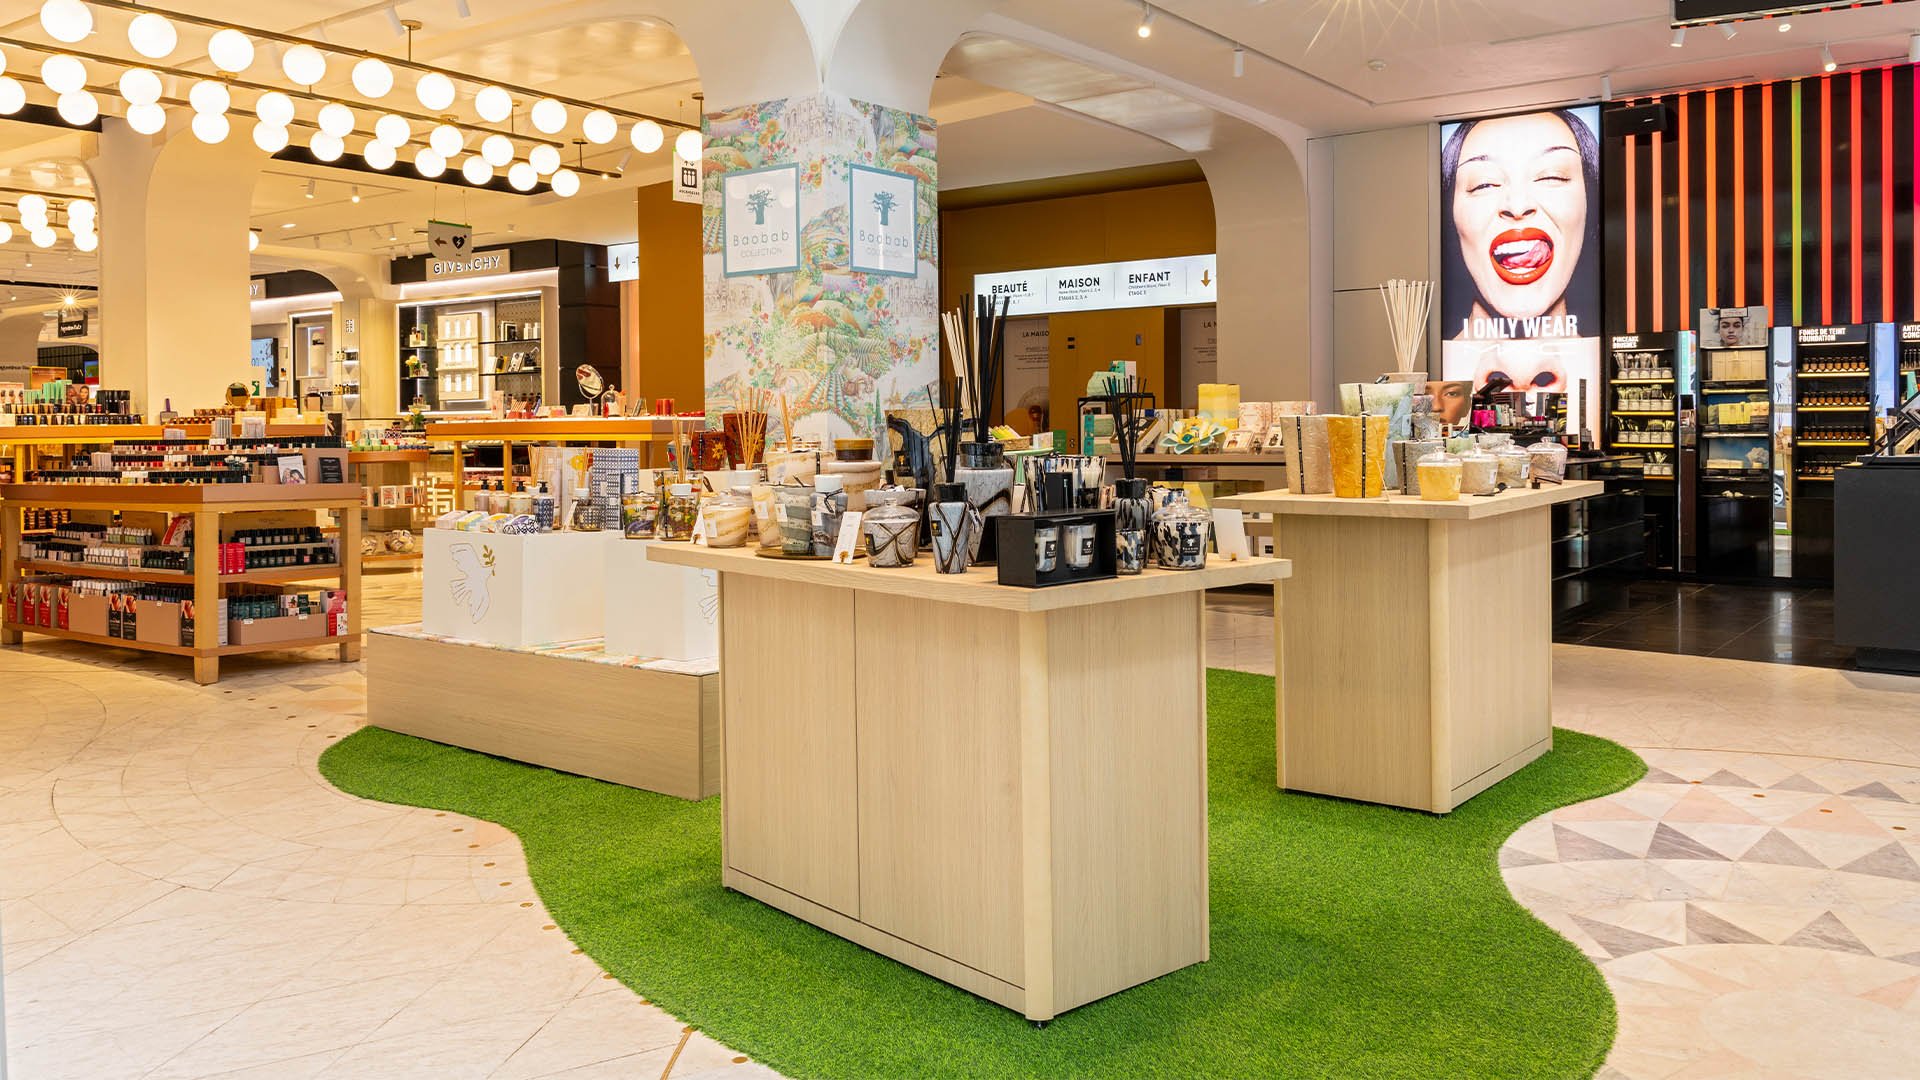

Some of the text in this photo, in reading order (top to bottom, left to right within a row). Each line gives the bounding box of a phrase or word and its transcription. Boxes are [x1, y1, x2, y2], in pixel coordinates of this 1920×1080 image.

[733, 229, 789, 247] Baobab
[859, 229, 909, 248] Baobab
[740, 247, 783, 258] COLLECTION
[433, 256, 500, 275] GIVENCHY
[1058, 276, 1100, 289] MAISON
[1128, 271, 1171, 284] ENFANT
[991, 280, 1028, 294] BEAUTÉ
[1463, 314, 1578, 338] I ONLY WEAR
[1798, 328, 1819, 336] FONDS
[1828, 327, 1847, 335] TEINT
[1798, 334, 1836, 342] FOUNDATION
